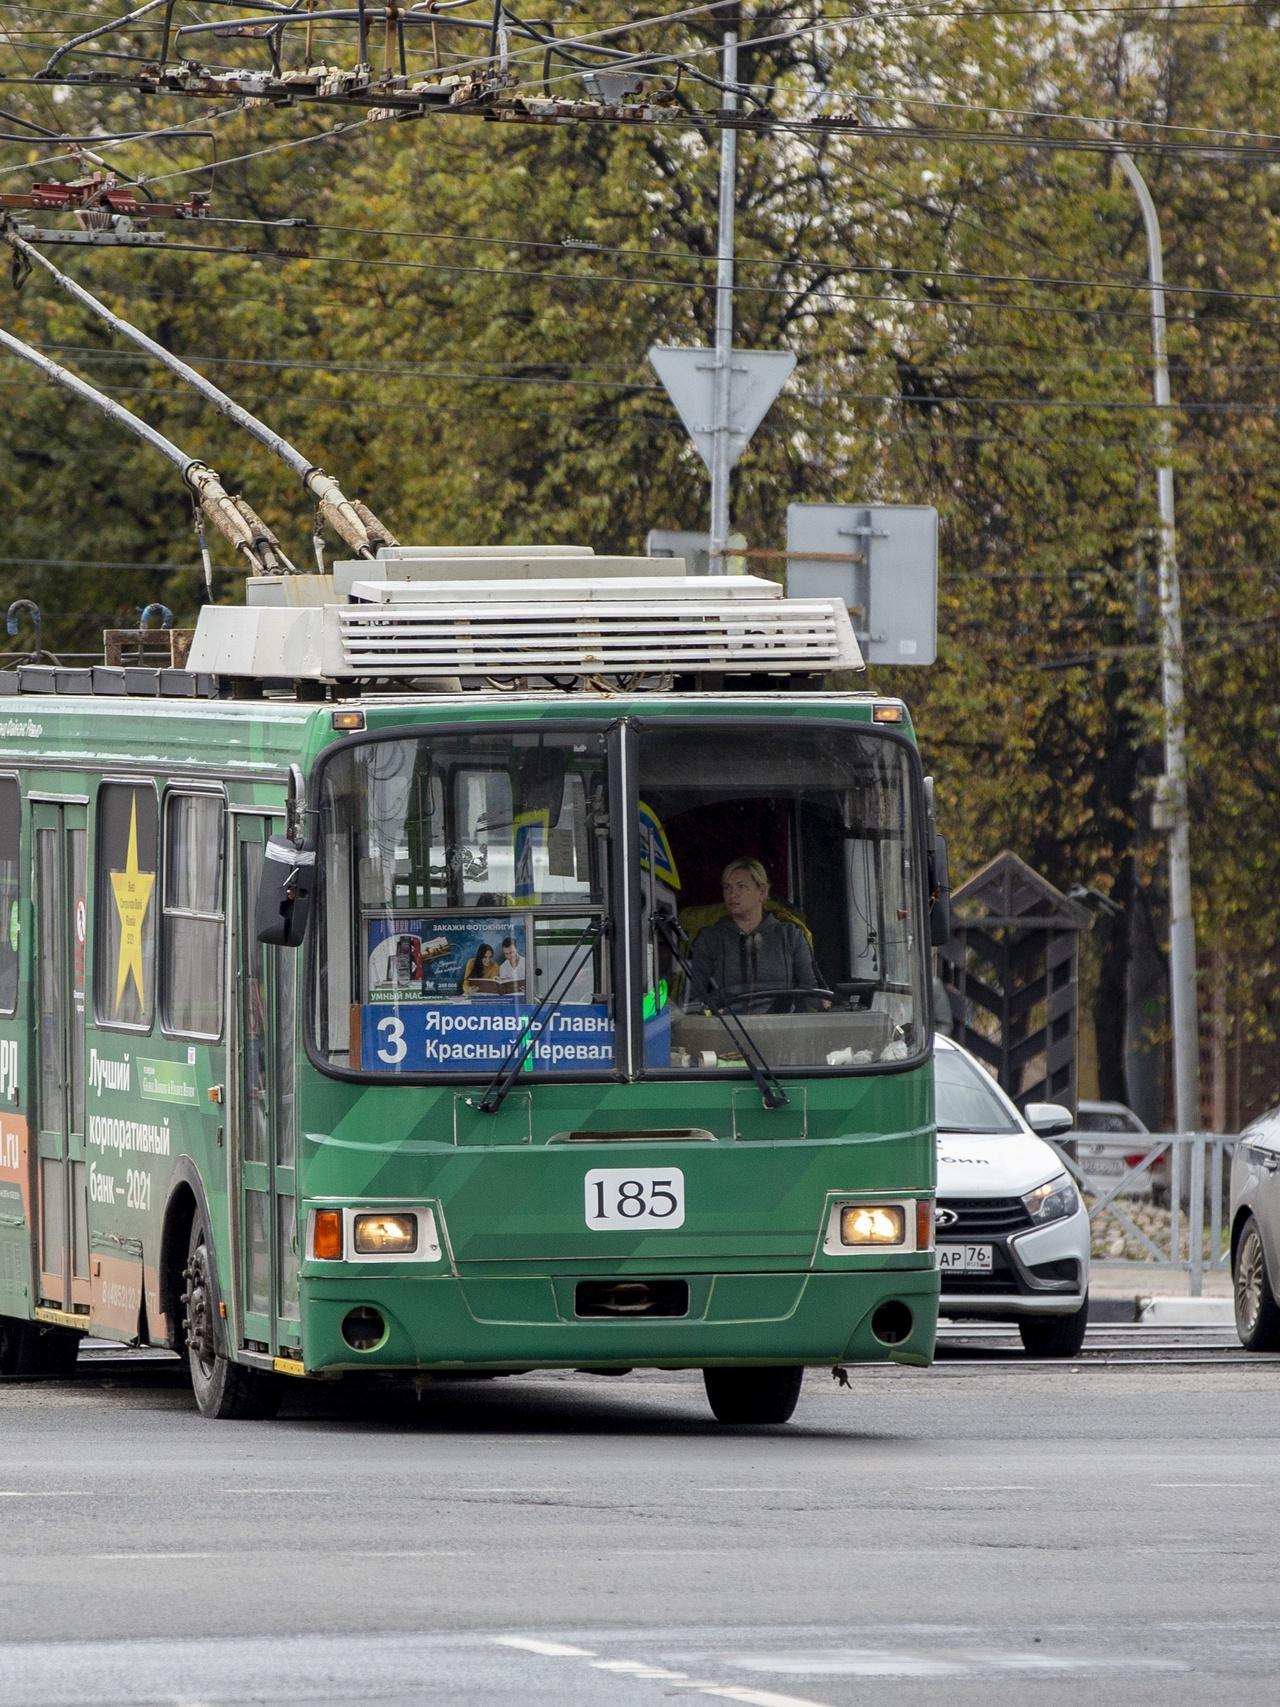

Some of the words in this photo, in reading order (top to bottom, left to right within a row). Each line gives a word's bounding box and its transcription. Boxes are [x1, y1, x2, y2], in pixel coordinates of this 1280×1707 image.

[371, 991, 403, 1001] УМНЫЙ
[376, 1016, 408, 1064] 3
[425, 1011, 542, 1035] Ярославль
[426, 1039, 519, 1063] Красный
[526, 1041, 613, 1064] Перевал
[89, 1048, 130, 1097] Лучший
[90, 1115, 170, 1157] корпоративный
[90, 1161, 115, 1204] банк
[126, 1168, 151, 1211] 2021
[592, 1180, 677, 1218] 185
[968, 1247, 986, 1262] 76
